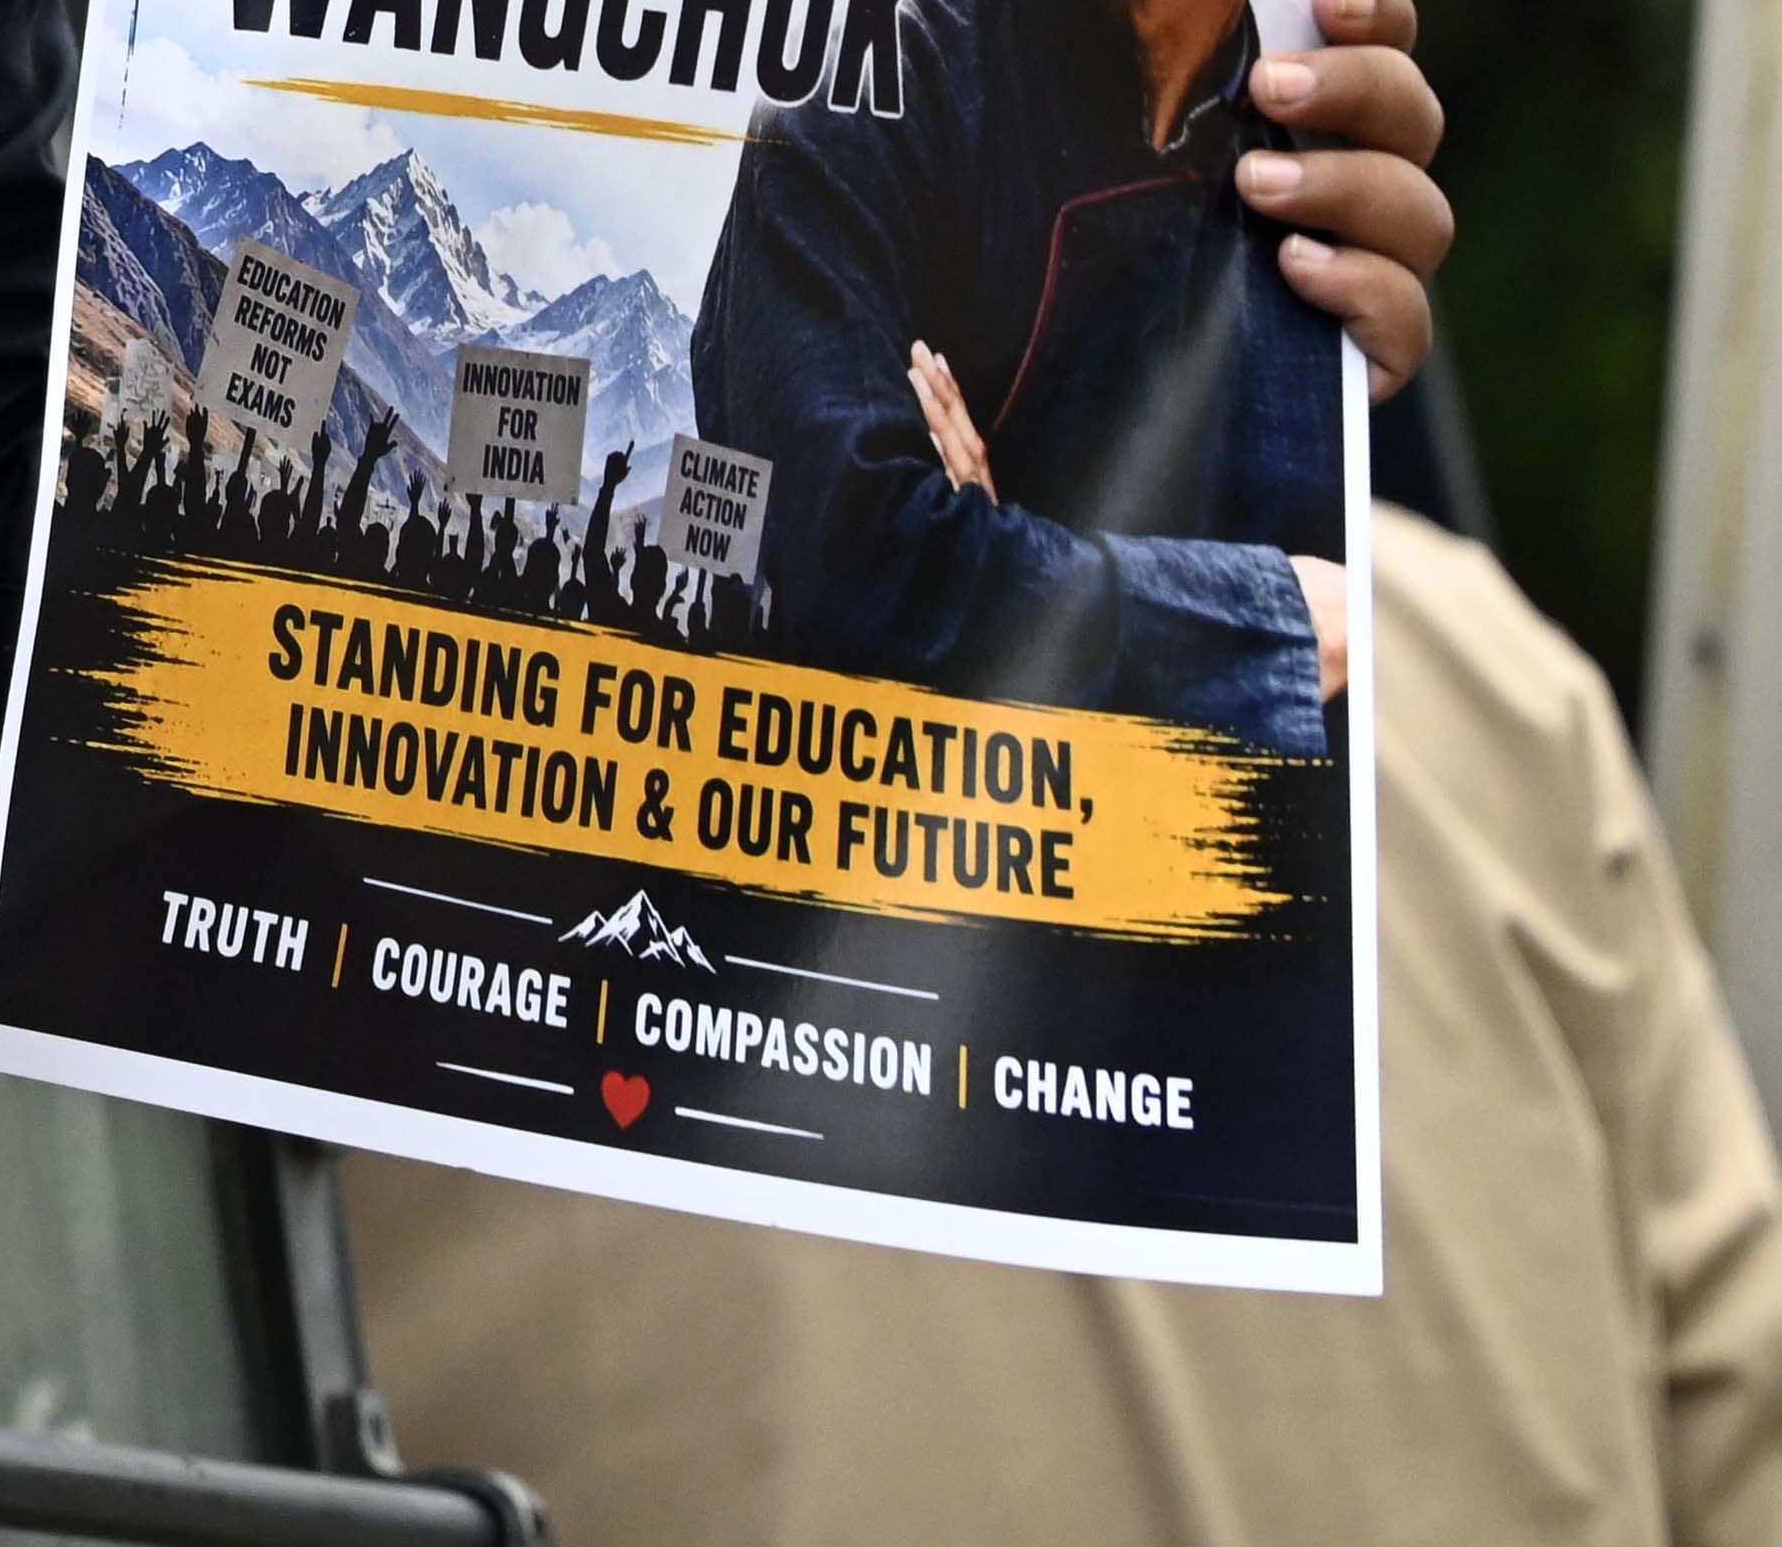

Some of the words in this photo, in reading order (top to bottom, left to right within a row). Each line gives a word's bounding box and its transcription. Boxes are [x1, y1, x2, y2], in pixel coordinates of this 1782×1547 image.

[237, 255, 346, 330] EDUCATION
[234, 295, 328, 362] REFORMS
[250, 343, 292, 385] NOT
[462, 362, 581, 406] INNOVATION
[225, 372, 296, 428] EXAMS
[498, 407, 538, 441] FOR
[482, 444, 545, 485] INDIA
[680, 450, 760, 498] CLIMATE
[679, 487, 747, 530] ACTION
[685, 524, 731, 563] NOW
[268, 603, 560, 727] STANDING
[581, 670, 696, 752] FOR
[717, 689, 1094, 825] EDUCATION,
[284, 703, 618, 833] INNOVATION
[637, 770, 675, 841] &
[697, 777, 814, 865] OUR
[836, 801, 1075, 900] FUTURE
[161, 891, 310, 973] TRUTH
[372, 936, 570, 1030] COURAGE
[633, 993, 932, 1097] COMPASSION
[993, 1056, 1195, 1132] CHANGE
